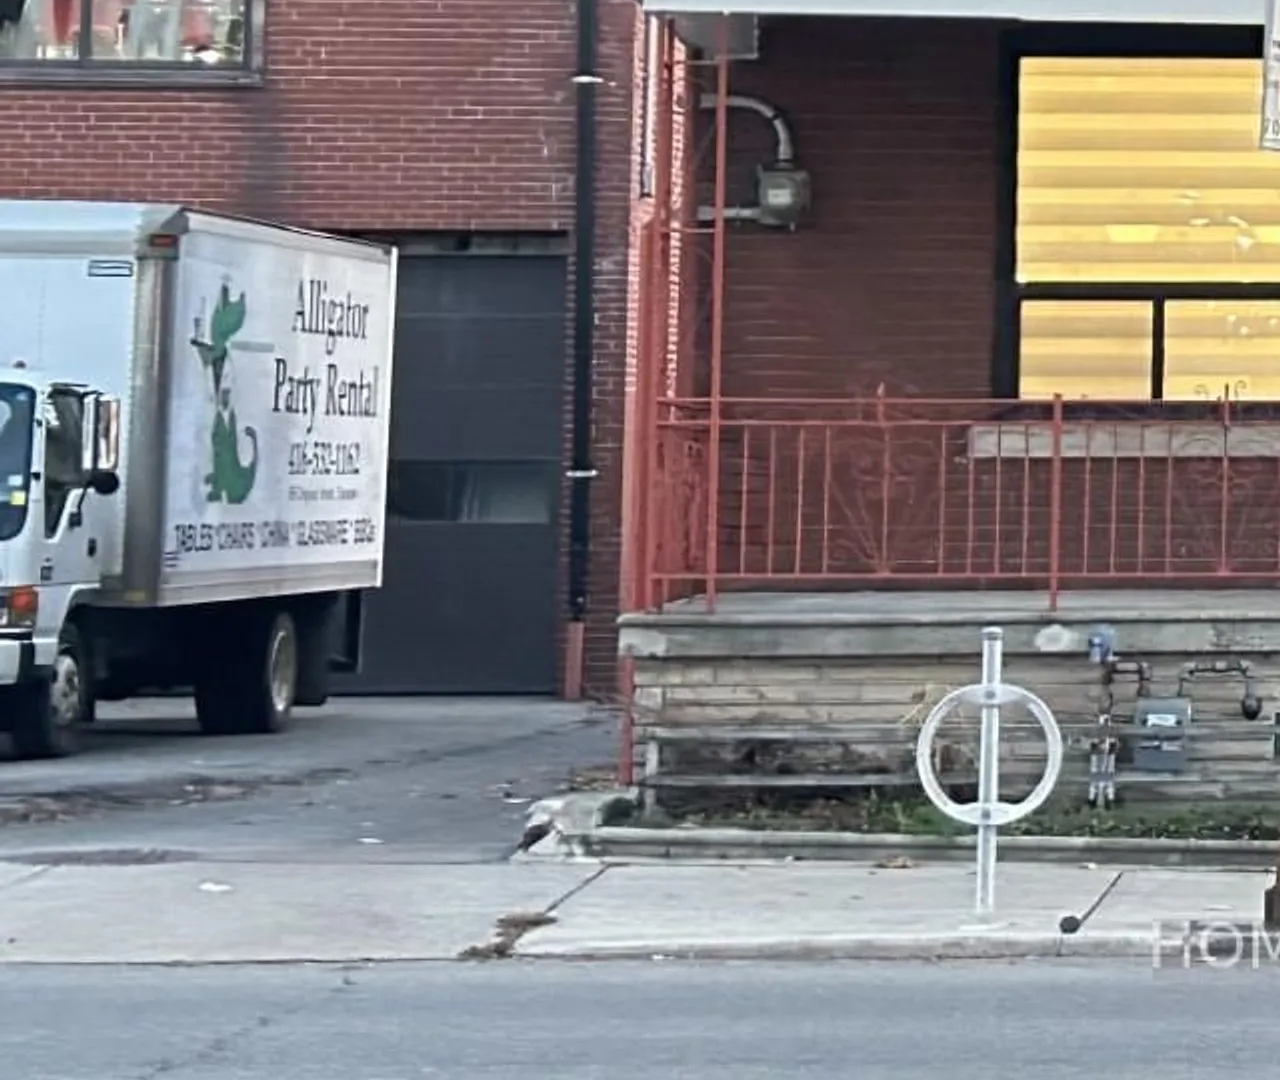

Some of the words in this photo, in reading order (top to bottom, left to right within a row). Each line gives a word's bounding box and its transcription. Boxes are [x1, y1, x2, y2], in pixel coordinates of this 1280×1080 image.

[291, 279, 369, 356] Alligator
[272, 358, 321, 434] Party
[325, 363, 379, 417] Rental
